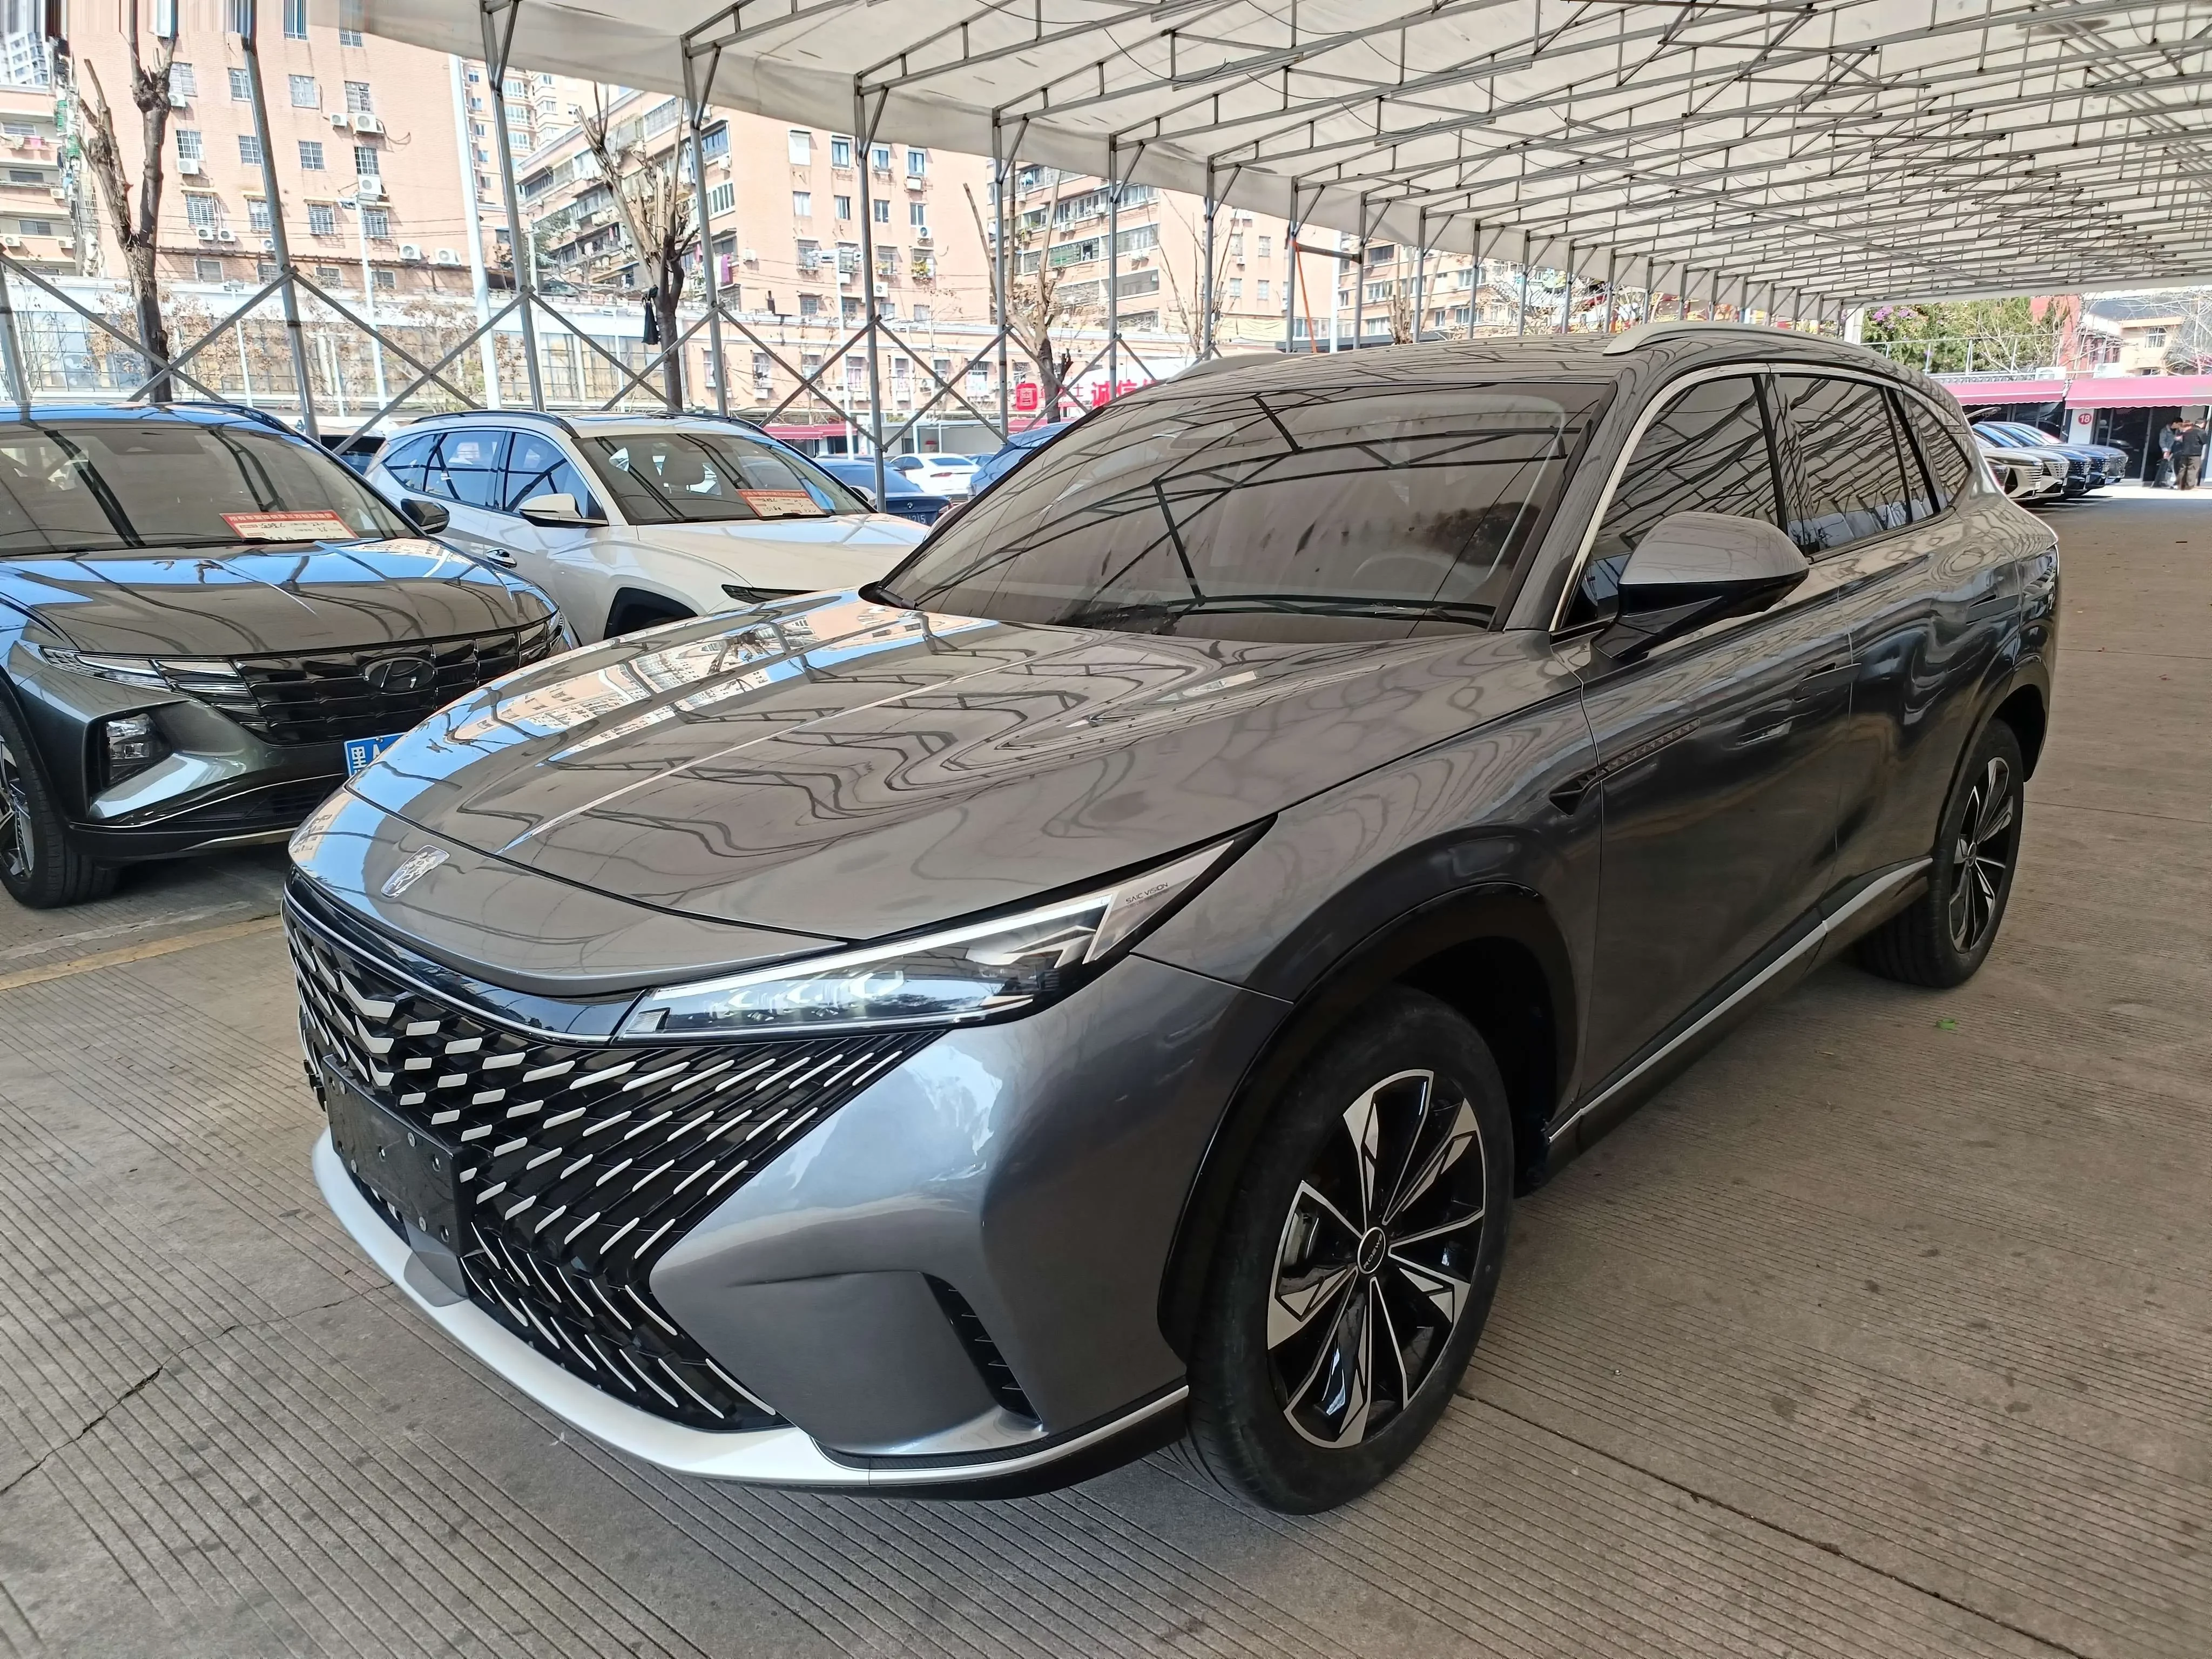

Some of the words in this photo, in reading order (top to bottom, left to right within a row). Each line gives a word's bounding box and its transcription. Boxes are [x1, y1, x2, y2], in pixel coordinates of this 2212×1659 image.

[1091, 380, 1155, 407] 诚信
[2080, 415, 2090, 423] 18
[1125, 892, 1144, 904] SAIC
[1144, 882, 1168, 895] VISION
[1363, 1233, 1382, 1269] ROEWE
